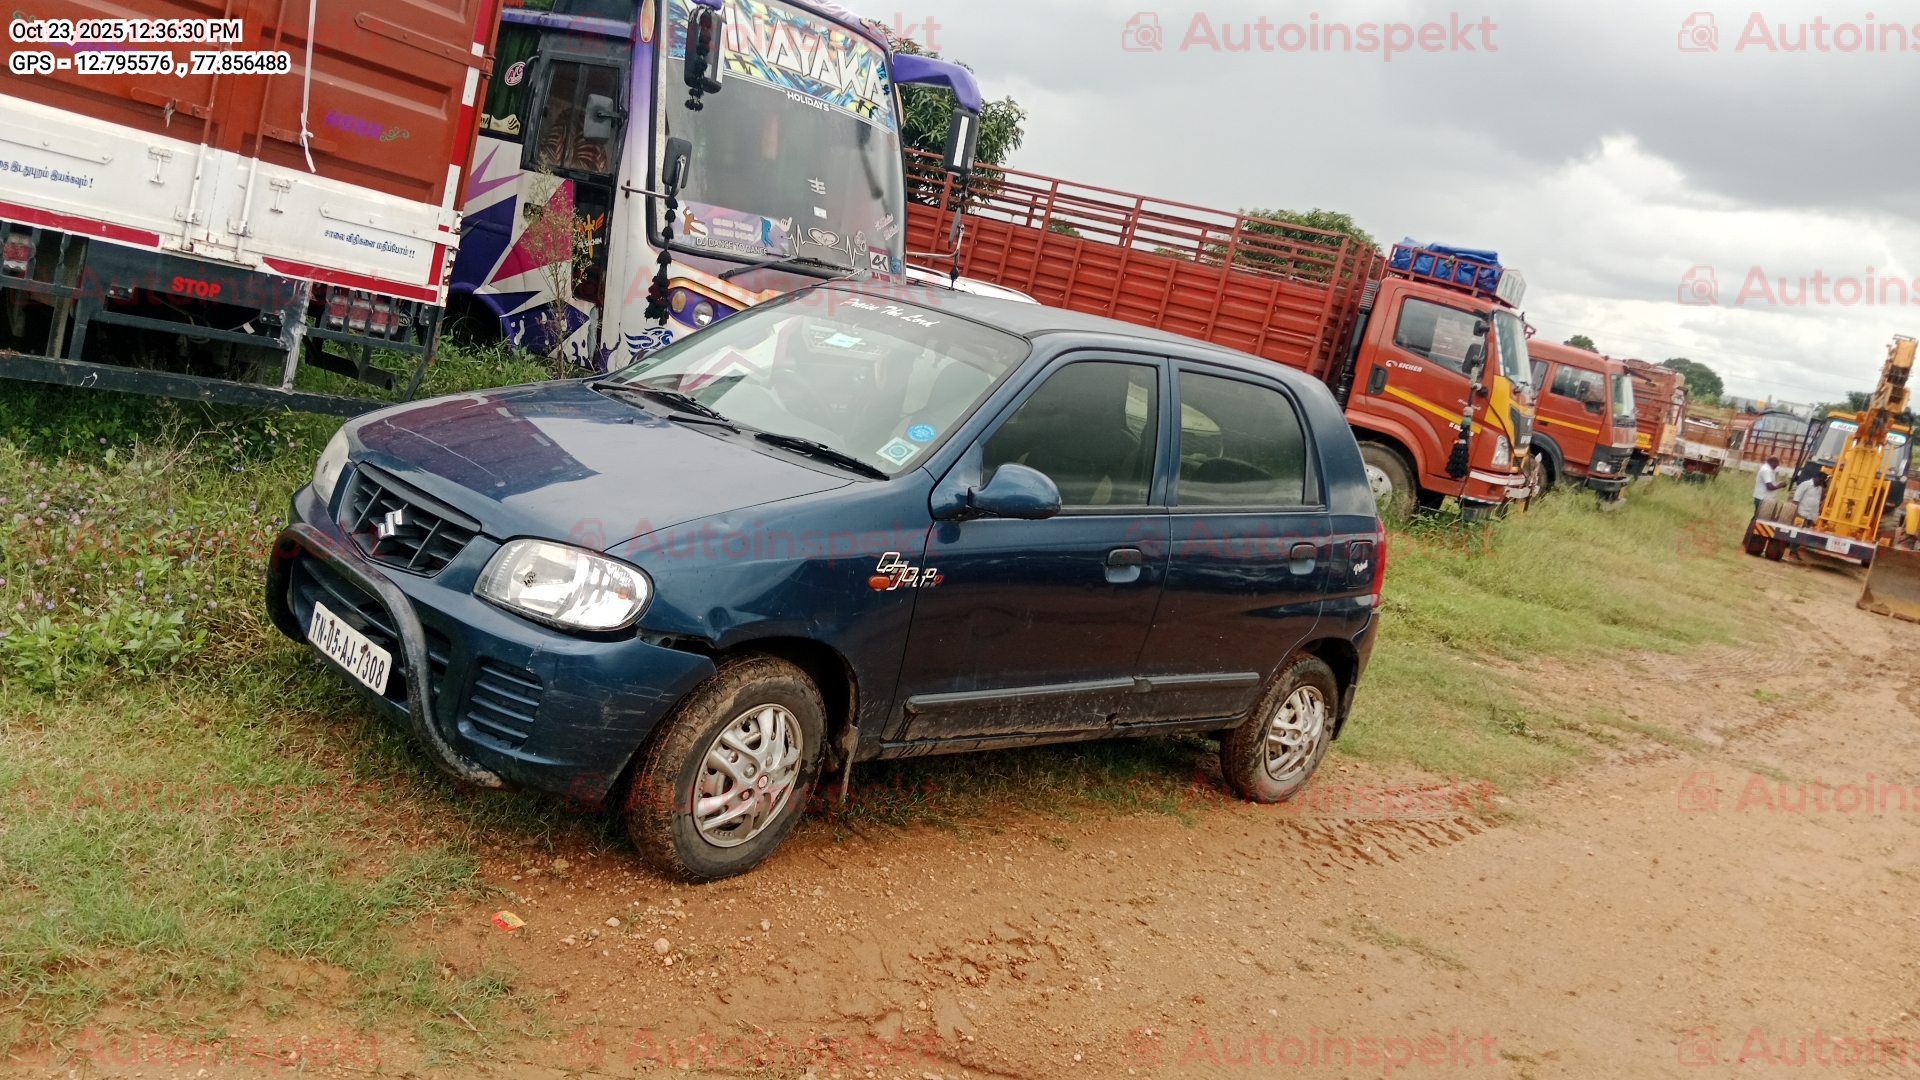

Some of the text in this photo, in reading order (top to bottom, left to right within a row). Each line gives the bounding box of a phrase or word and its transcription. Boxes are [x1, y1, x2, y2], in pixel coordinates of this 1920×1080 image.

[787, 90, 830, 112] HOLIDAYS
[323, 109, 384, 139] HORN
[696, 237, 707, 247] DJ
[708, 239, 734, 250] DANCE
[735, 242, 745, 252] TO
[171, 276, 222, 298] STOP
[840, 298, 940, 327] Praise The Lord
[1398, 362, 1423, 373] EICHER
[312, 611, 385, 689] TN-05-AJ-7308
